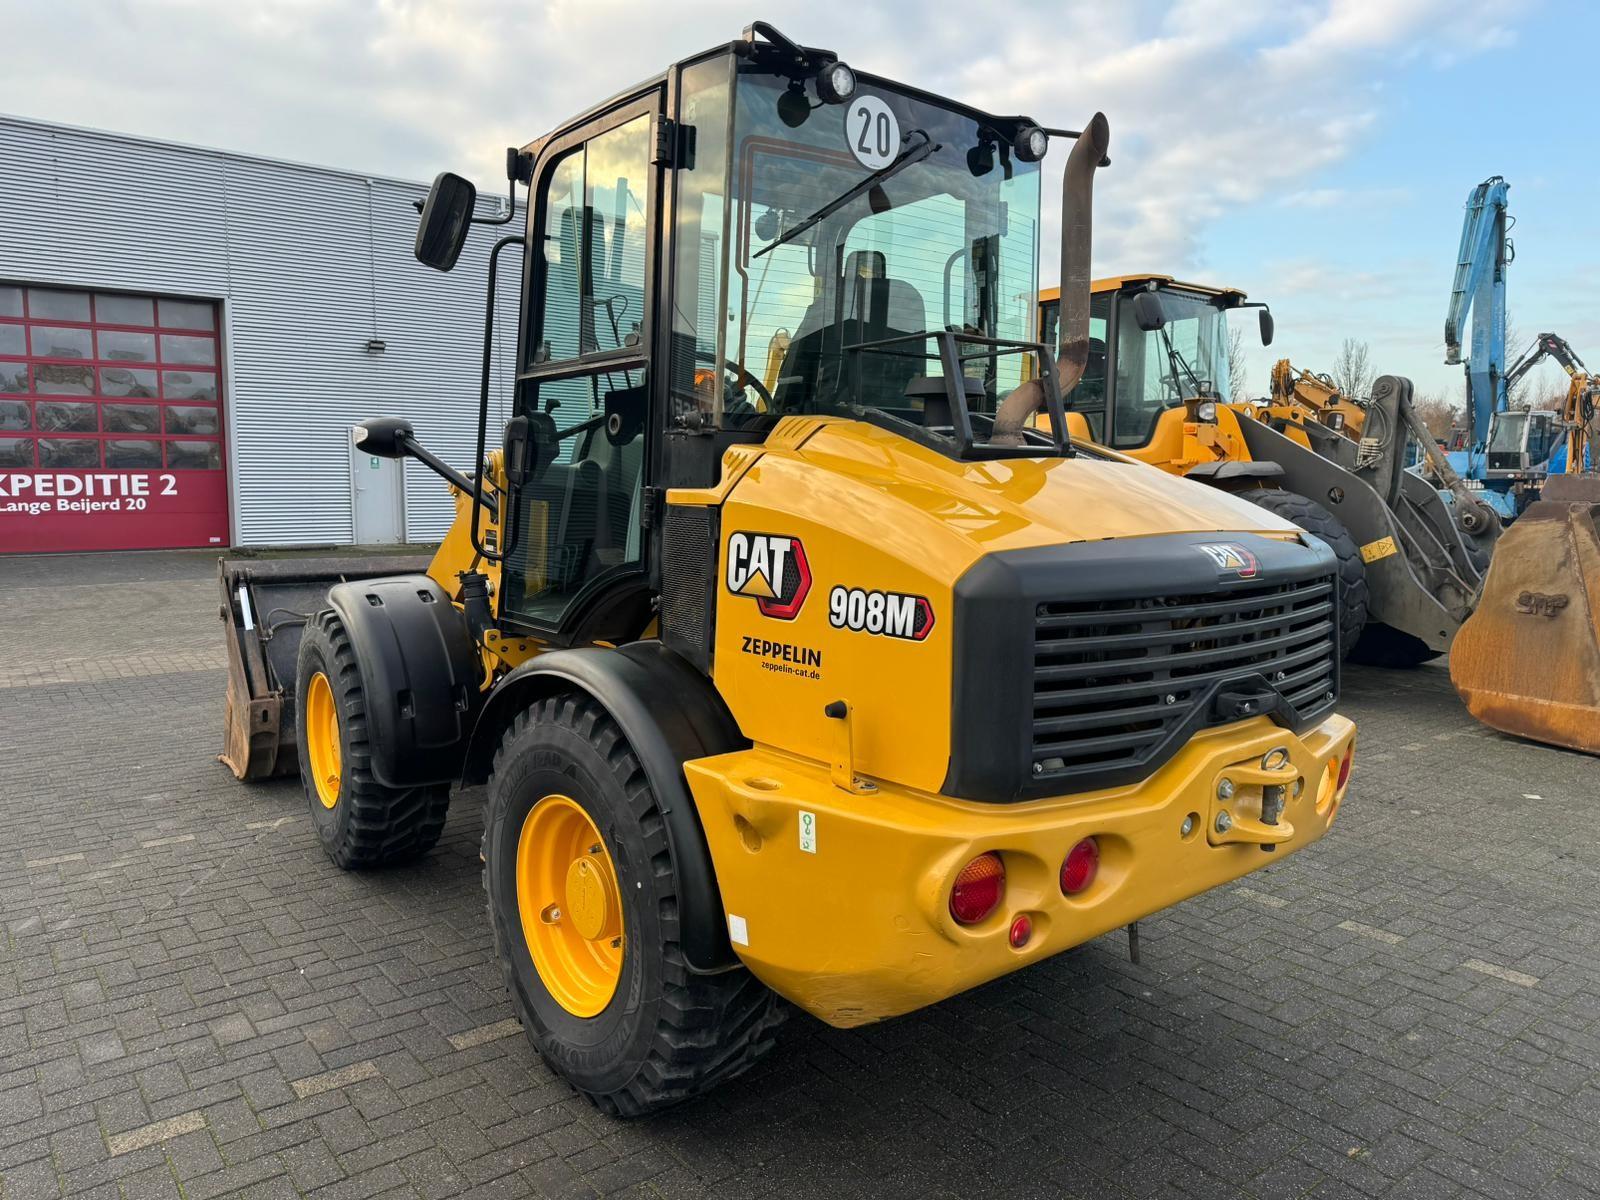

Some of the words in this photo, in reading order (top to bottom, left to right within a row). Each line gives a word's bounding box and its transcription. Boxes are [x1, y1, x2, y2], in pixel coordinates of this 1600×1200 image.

[858, 107, 890, 157] 20
[159, 474, 178, 496] 2
[57, 499, 120, 514] Beijerd
[126, 498, 147, 511] 20
[727, 532, 791, 599] CAT
[829, 586, 916, 637] 908M
[741, 636, 822, 668] ZEPPELIN
[761, 661, 821, 680] zeppelin-cat.de
